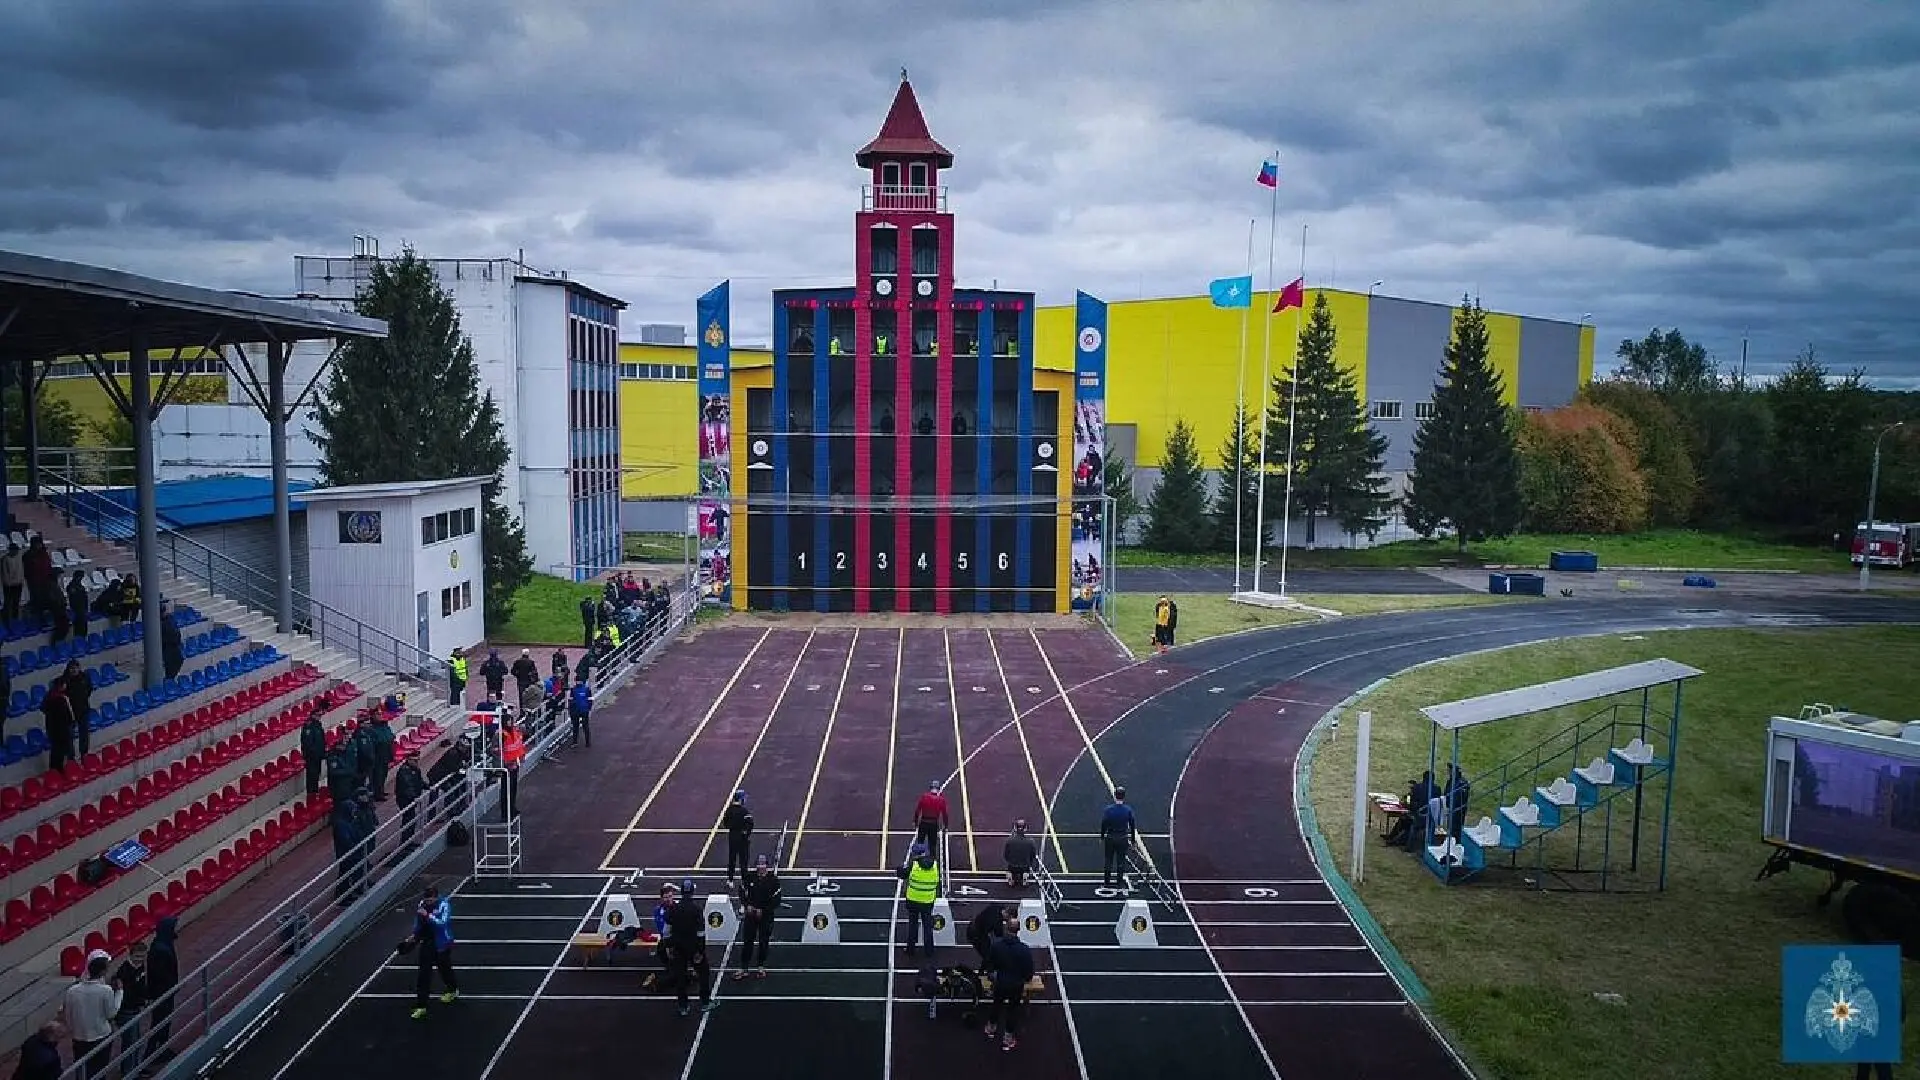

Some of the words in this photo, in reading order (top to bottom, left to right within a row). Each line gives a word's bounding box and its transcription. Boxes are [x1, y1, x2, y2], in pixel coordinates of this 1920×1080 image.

[797, 552, 806, 569] 1
[836, 552, 847, 569] 2
[878, 552, 888, 569] 3
[917, 552, 927, 570] 4
[958, 552, 968, 569] 5
[998, 552, 1008, 569] 6
[1504, 577, 1510, 592] 1
[954, 885, 988, 895] 4
[1244, 888, 1279, 898] 6
